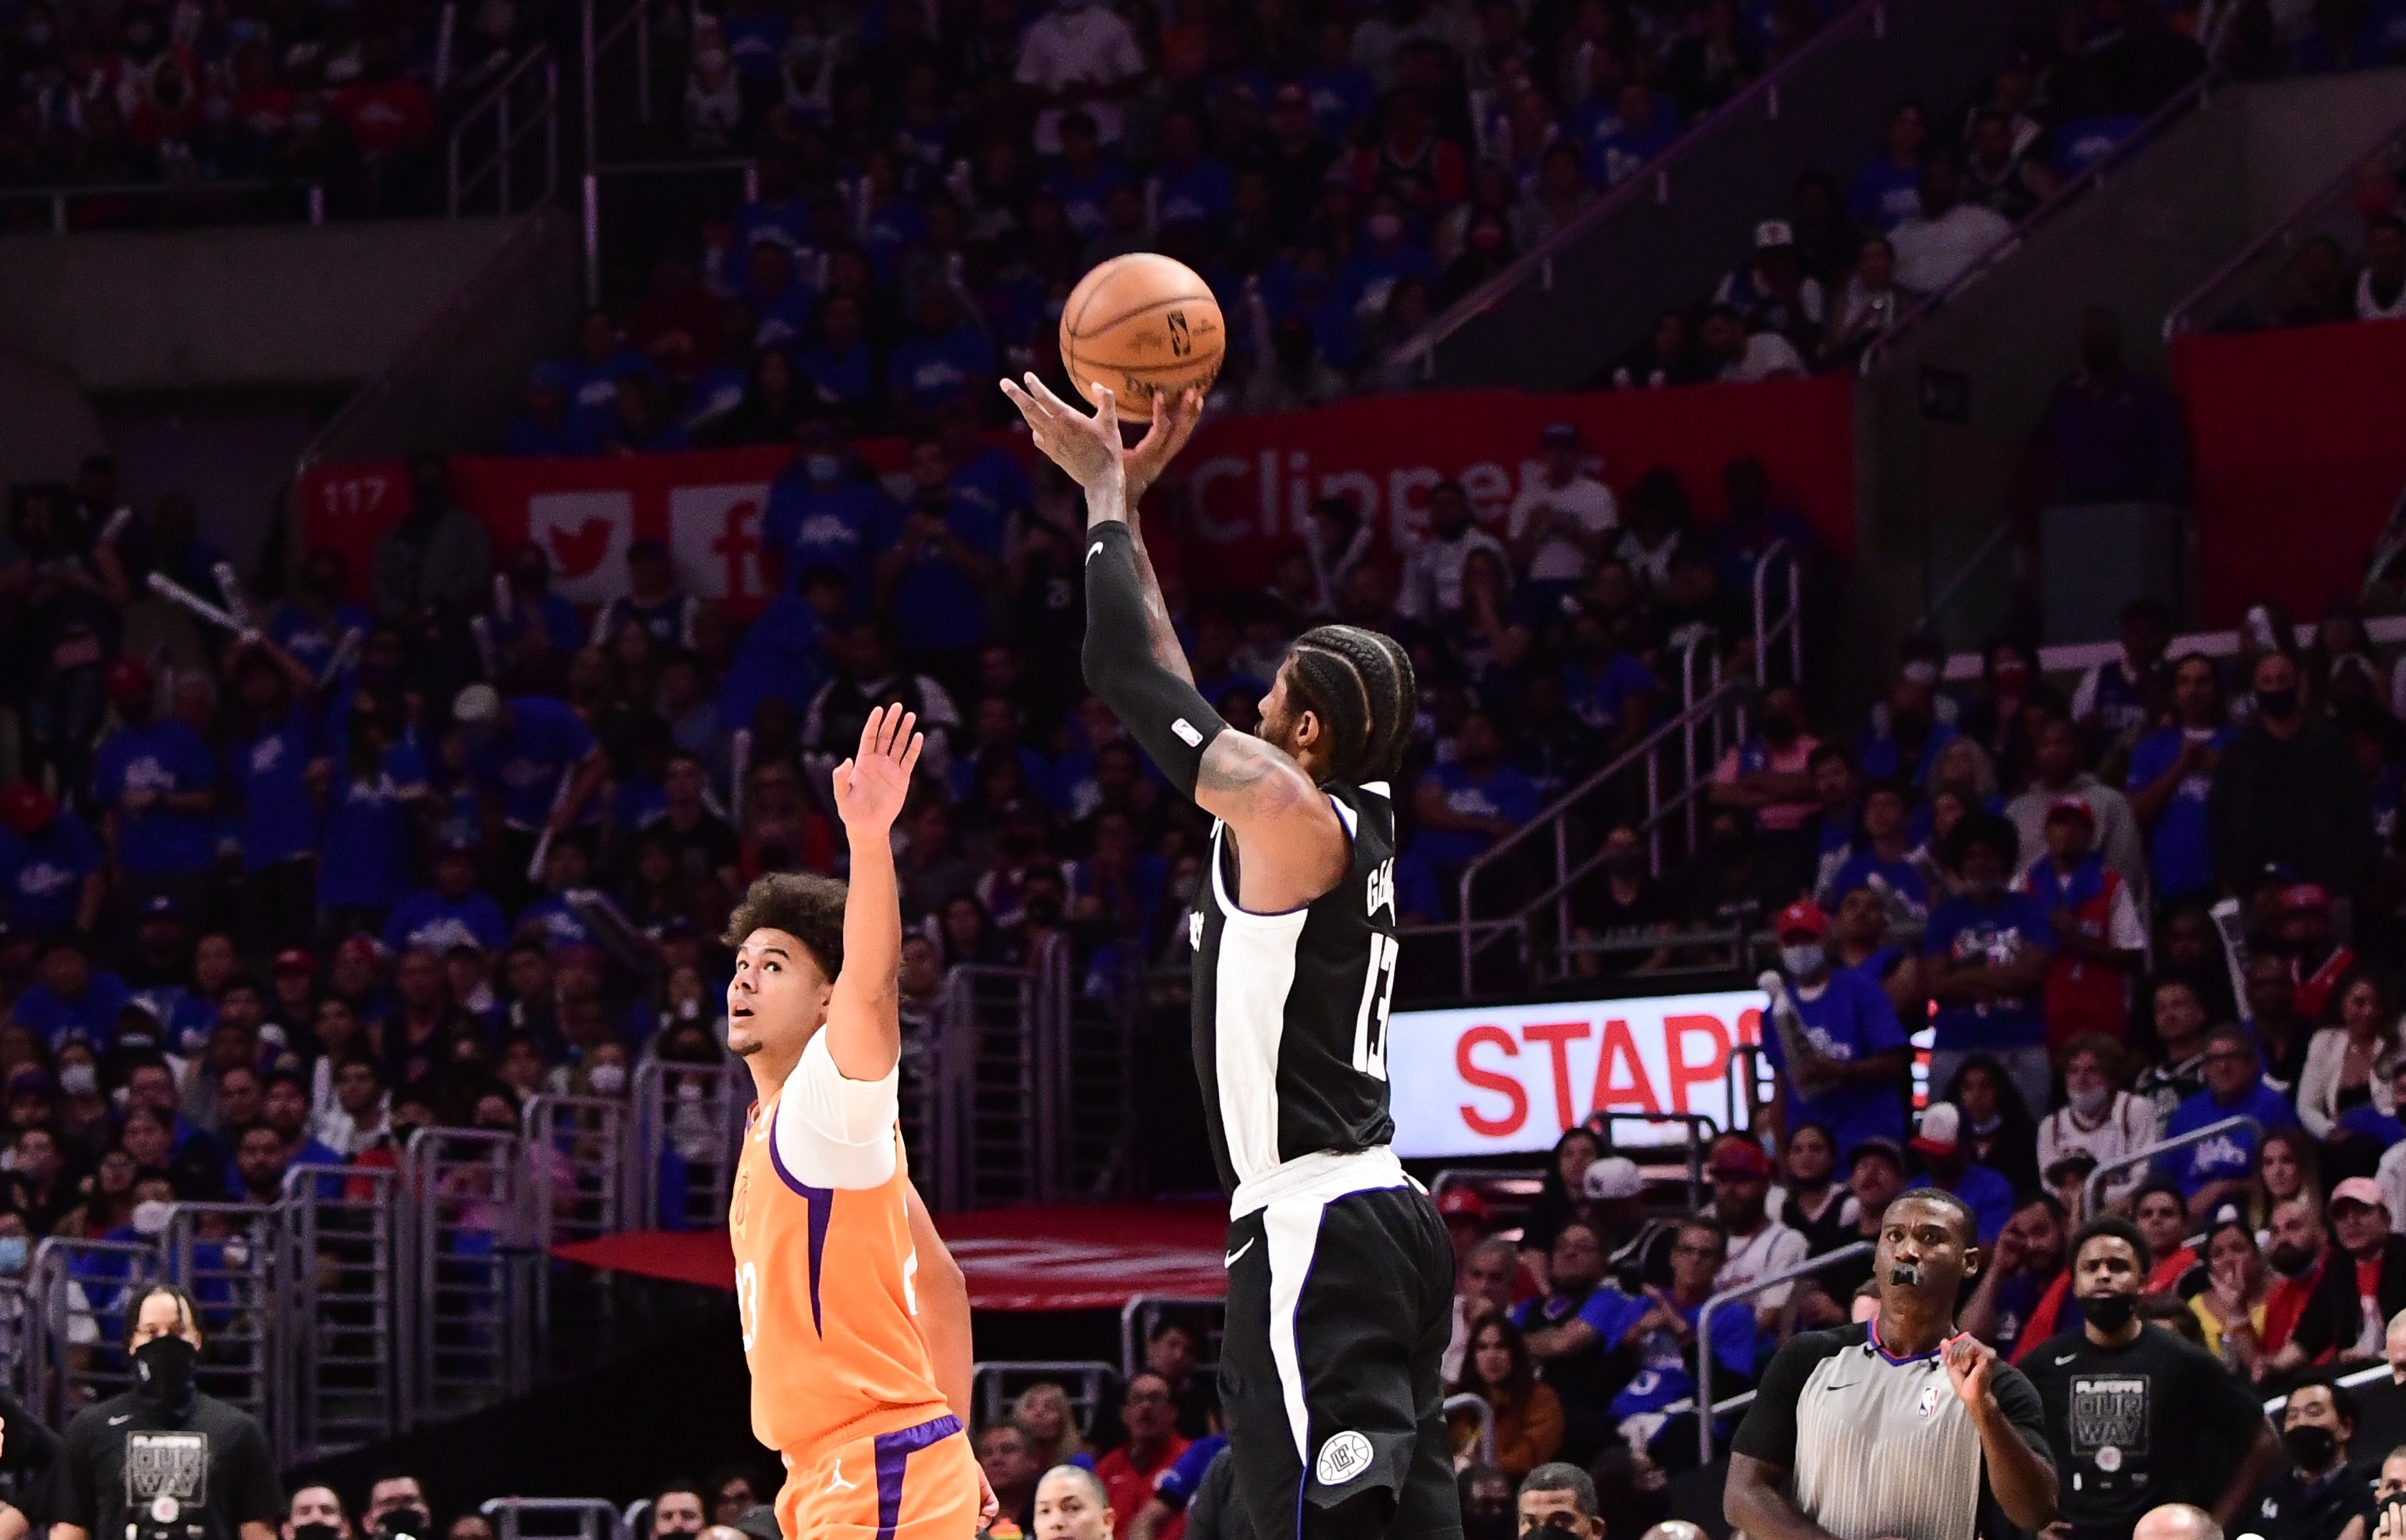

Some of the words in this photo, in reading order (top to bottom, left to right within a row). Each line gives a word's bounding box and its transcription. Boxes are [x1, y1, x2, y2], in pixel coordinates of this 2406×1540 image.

[324, 476, 387, 516] 117
[1353, 932, 1399, 1082] 13
[736, 1261, 757, 1352] 3
